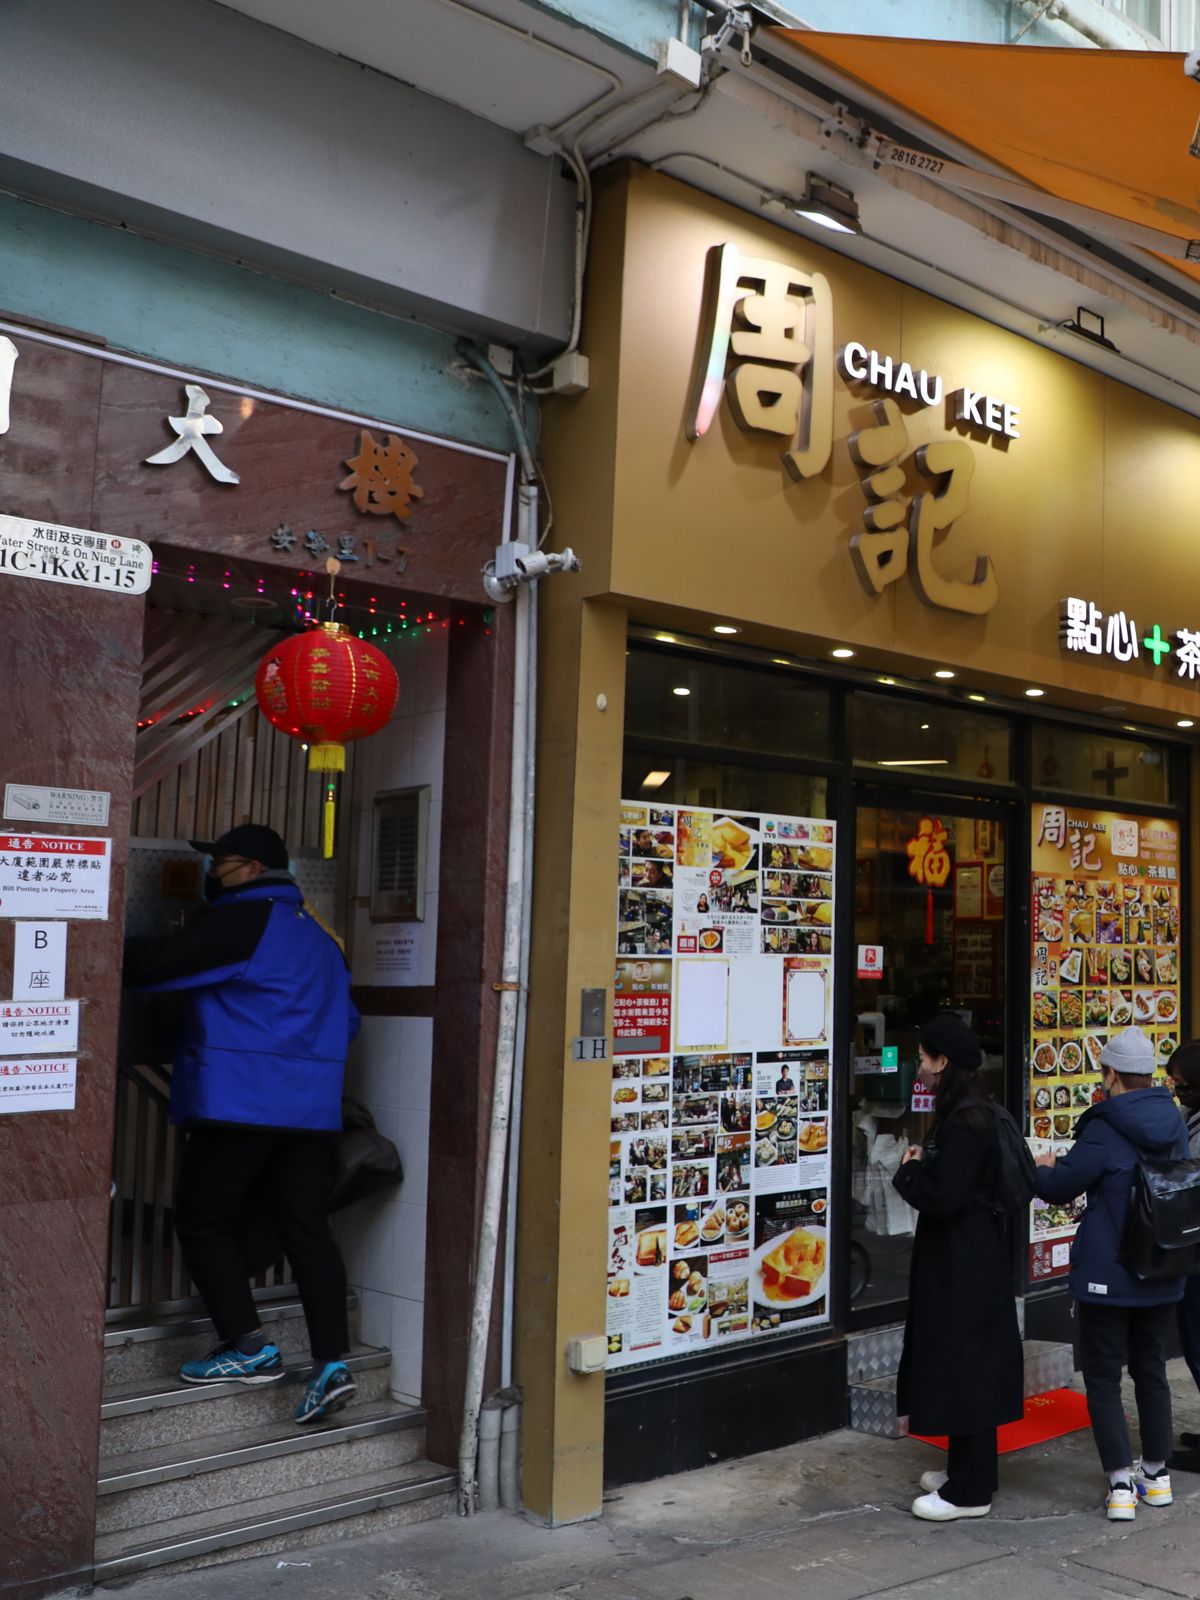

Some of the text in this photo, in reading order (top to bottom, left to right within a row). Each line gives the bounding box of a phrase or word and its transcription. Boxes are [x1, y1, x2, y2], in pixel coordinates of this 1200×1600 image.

[890, 148, 945, 173] 2816 2727
[840, 341, 1021, 440] CHAU KEE
[0, 534, 144, 570] ater Street & On Ning Lane
[1066, 819, 1107, 832] CHAU KEE
[8, 838, 85, 851] 通告 NOTICE
[1037, 807, 1102, 871] 周記
[17, 870, 73, 883] 違者必究
[16, 885, 41, 894] Posting
[50, 887, 78, 895] Property
[34, 930, 48, 949] B
[28, 970, 51, 989] 座
[1, 1005, 71, 1017] 通告 NOTICE
[25, 1062, 69, 1072] NOTICE
